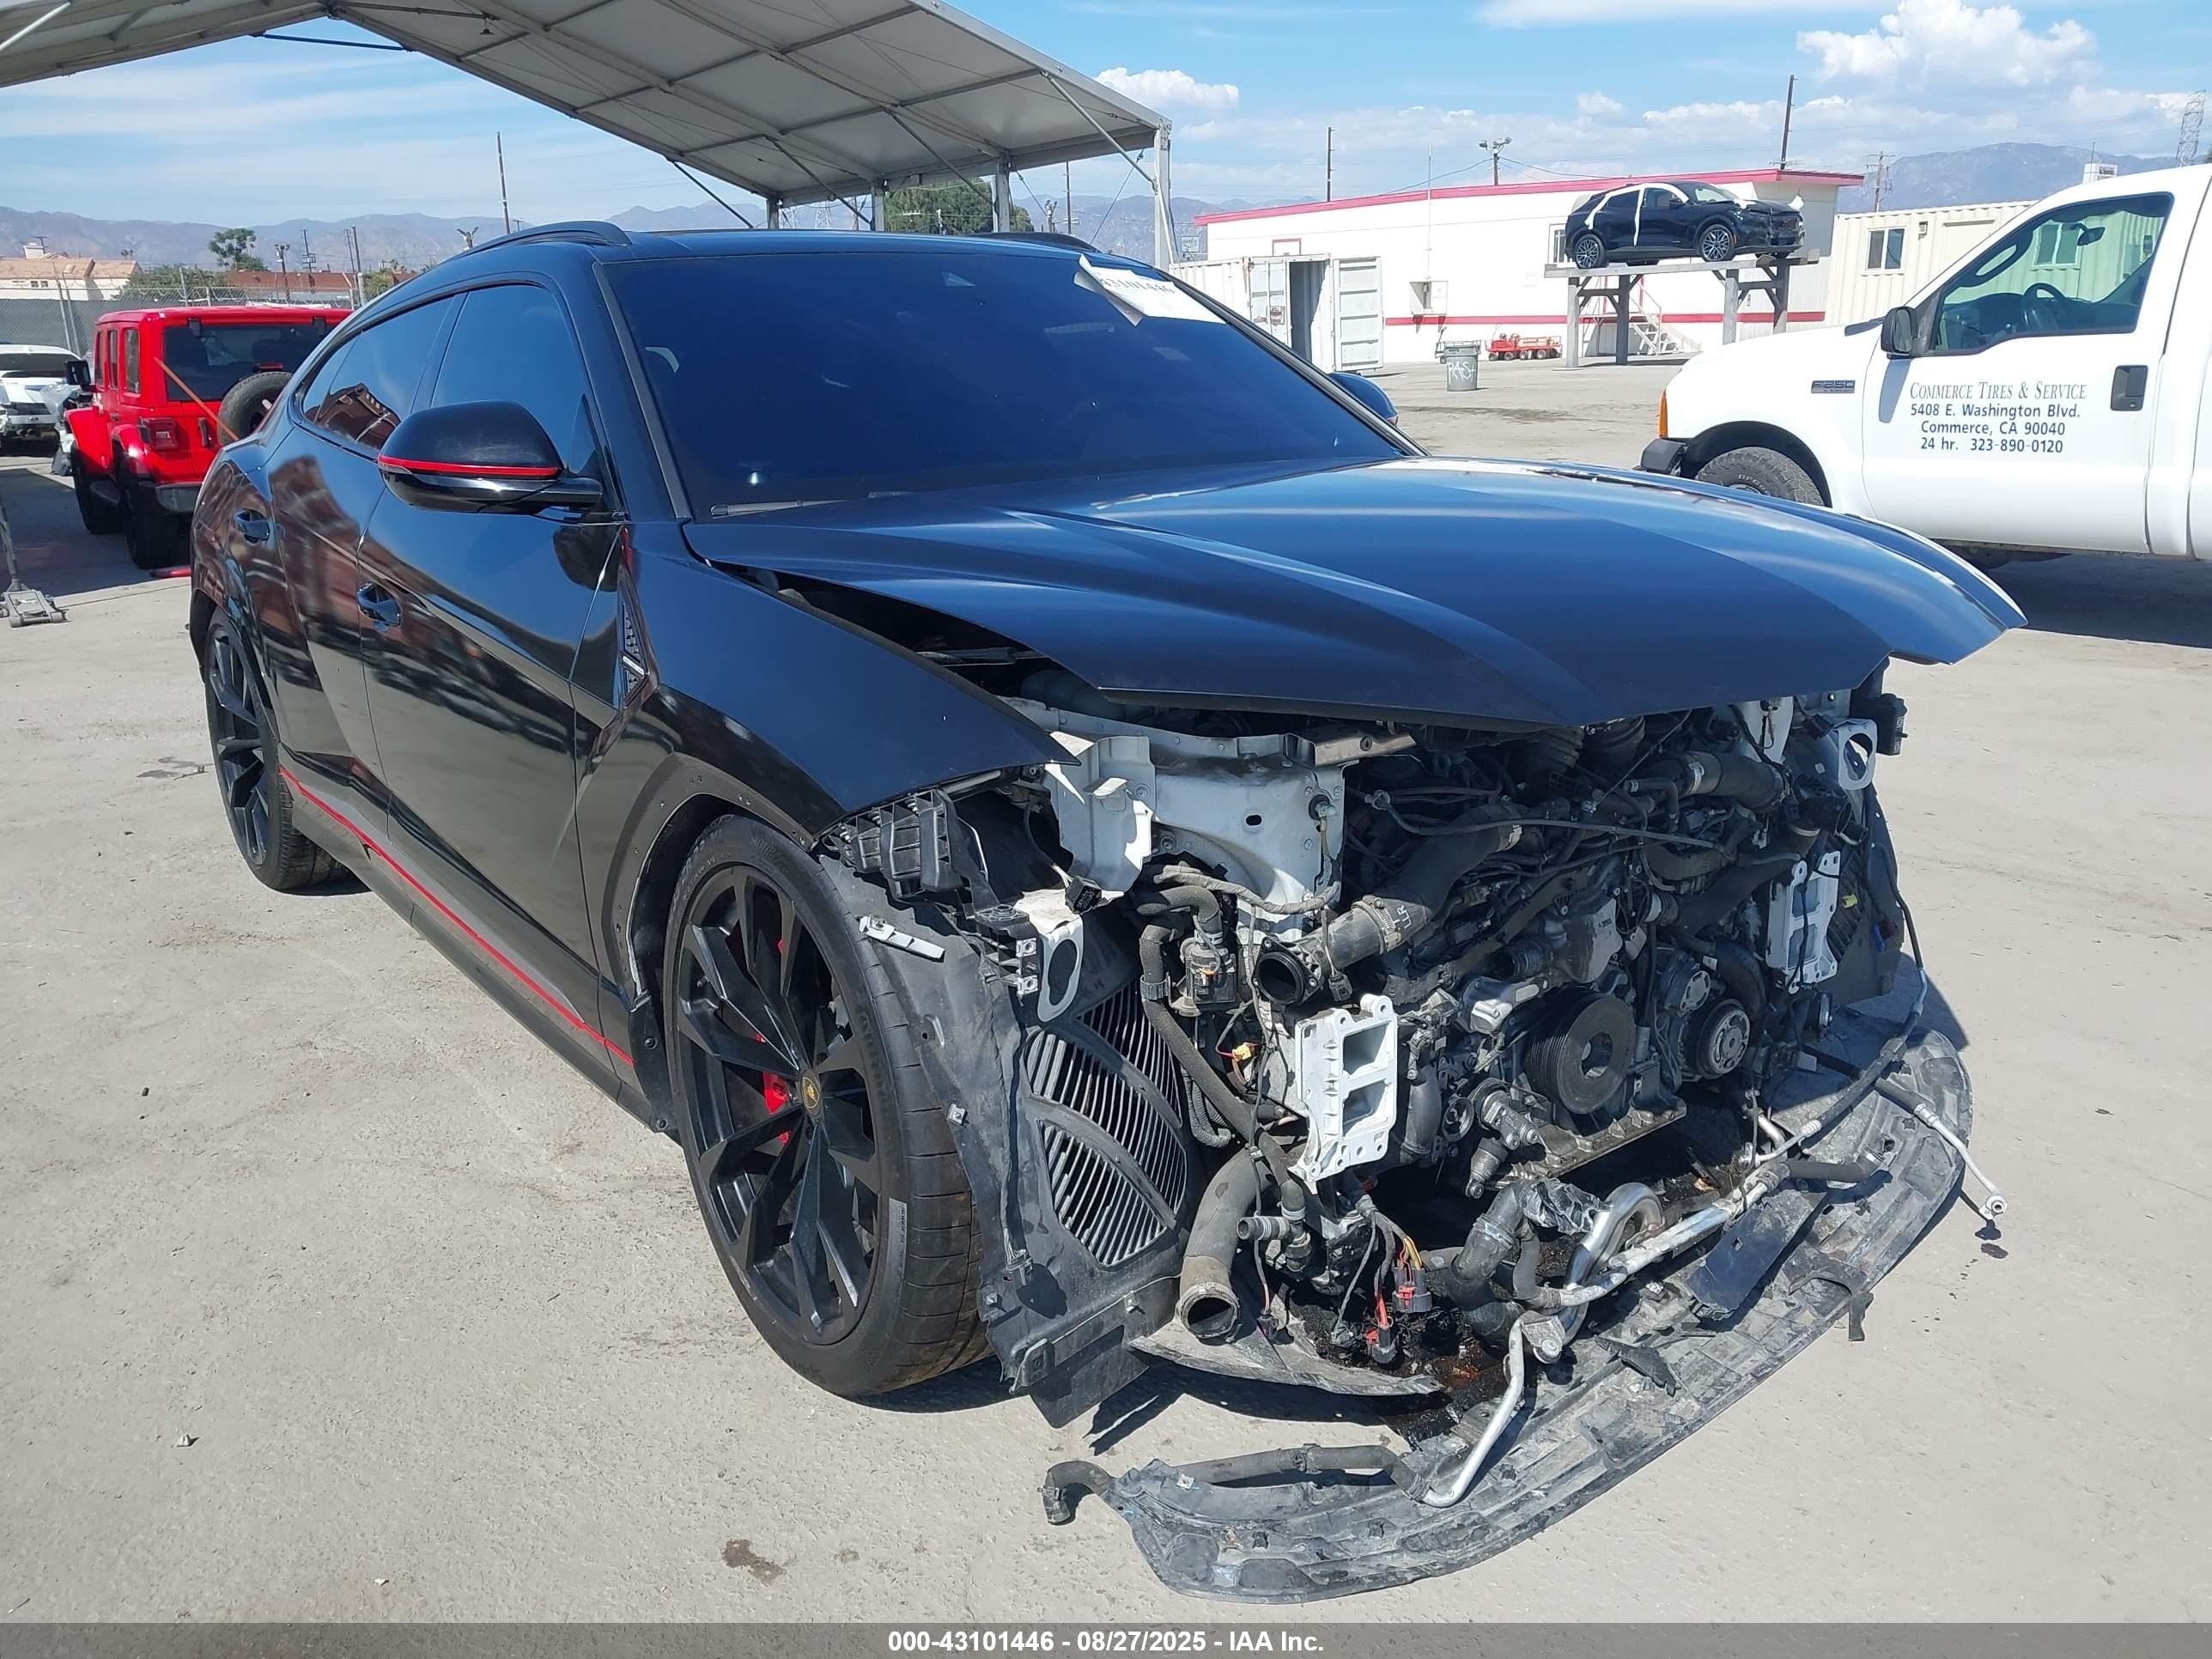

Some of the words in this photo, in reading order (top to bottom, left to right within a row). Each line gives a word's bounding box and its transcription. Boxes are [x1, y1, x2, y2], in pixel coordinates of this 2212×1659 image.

[1910, 381, 1973, 399] COMMERCE
[1978, 381, 2014, 399] TIRES
[2018, 382, 2029, 399] &
[2034, 381, 2087, 399] SERVICE
[1911, 403, 1940, 416] 5408
[1945, 404, 1956, 416] E.
[1962, 403, 2041, 420] Washington
[2047, 403, 2081, 418] Blvd.
[1921, 420, 1993, 436] Commerce,
[1999, 421, 2018, 434] CA
[2024, 422, 2066, 436] 90040
[1920, 436, 1936, 450] 24
[1941, 436, 1959, 450] hr.
[1970, 438, 2063, 453] 323-890-0120
